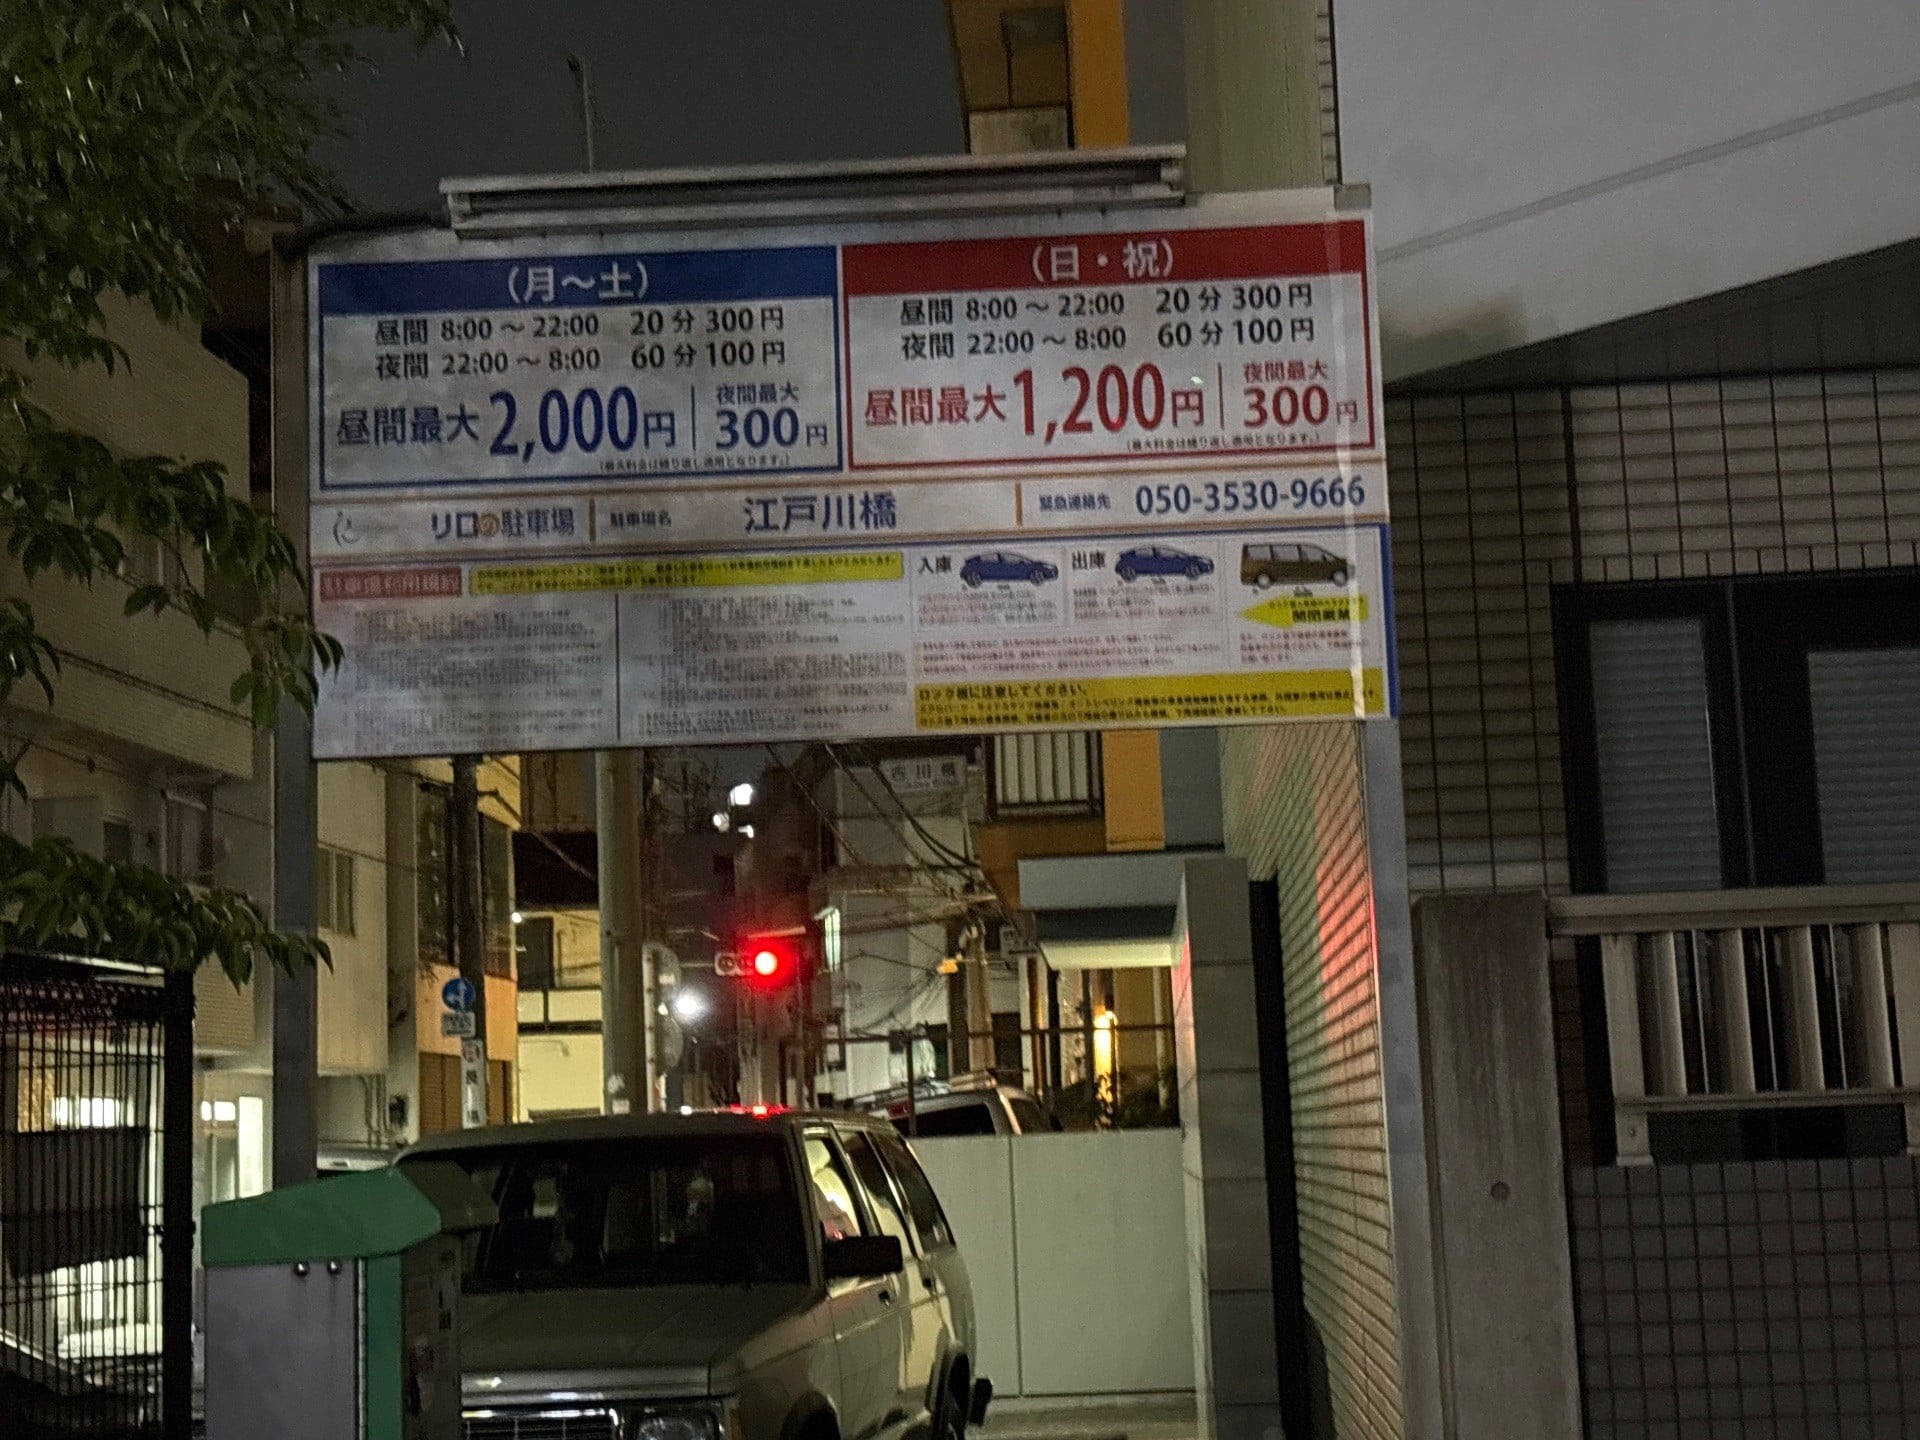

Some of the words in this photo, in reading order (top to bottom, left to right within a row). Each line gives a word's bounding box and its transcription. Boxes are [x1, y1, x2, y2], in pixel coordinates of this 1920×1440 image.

[1031, 242, 1174, 282] (日・祝)
[508, 261, 649, 302] (月～土)
[901, 298, 953, 325] 昼間
[376, 319, 428, 345] 昼間
[902, 333, 954, 360] 夜間
[376, 353, 428, 379] 夜間
[1243, 359, 1328, 383] 夜間最大
[715, 382, 799, 404] 夜間最大
[865, 385, 1007, 426] 昼間最大
[1242, 385, 1359, 428] 300円
[336, 404, 479, 447] 昼間最大
[714, 408, 829, 450] 300円
[1039, 494, 1111, 511] 緊急連絡先
[1135, 475, 1367, 516] 050-3530-9666
[431, 507, 575, 540] リロの駐車場
[744, 490, 897, 532] 江戸川橋
[918, 555, 952, 574] 入庫
[1072, 550, 1106, 571] 出庫
